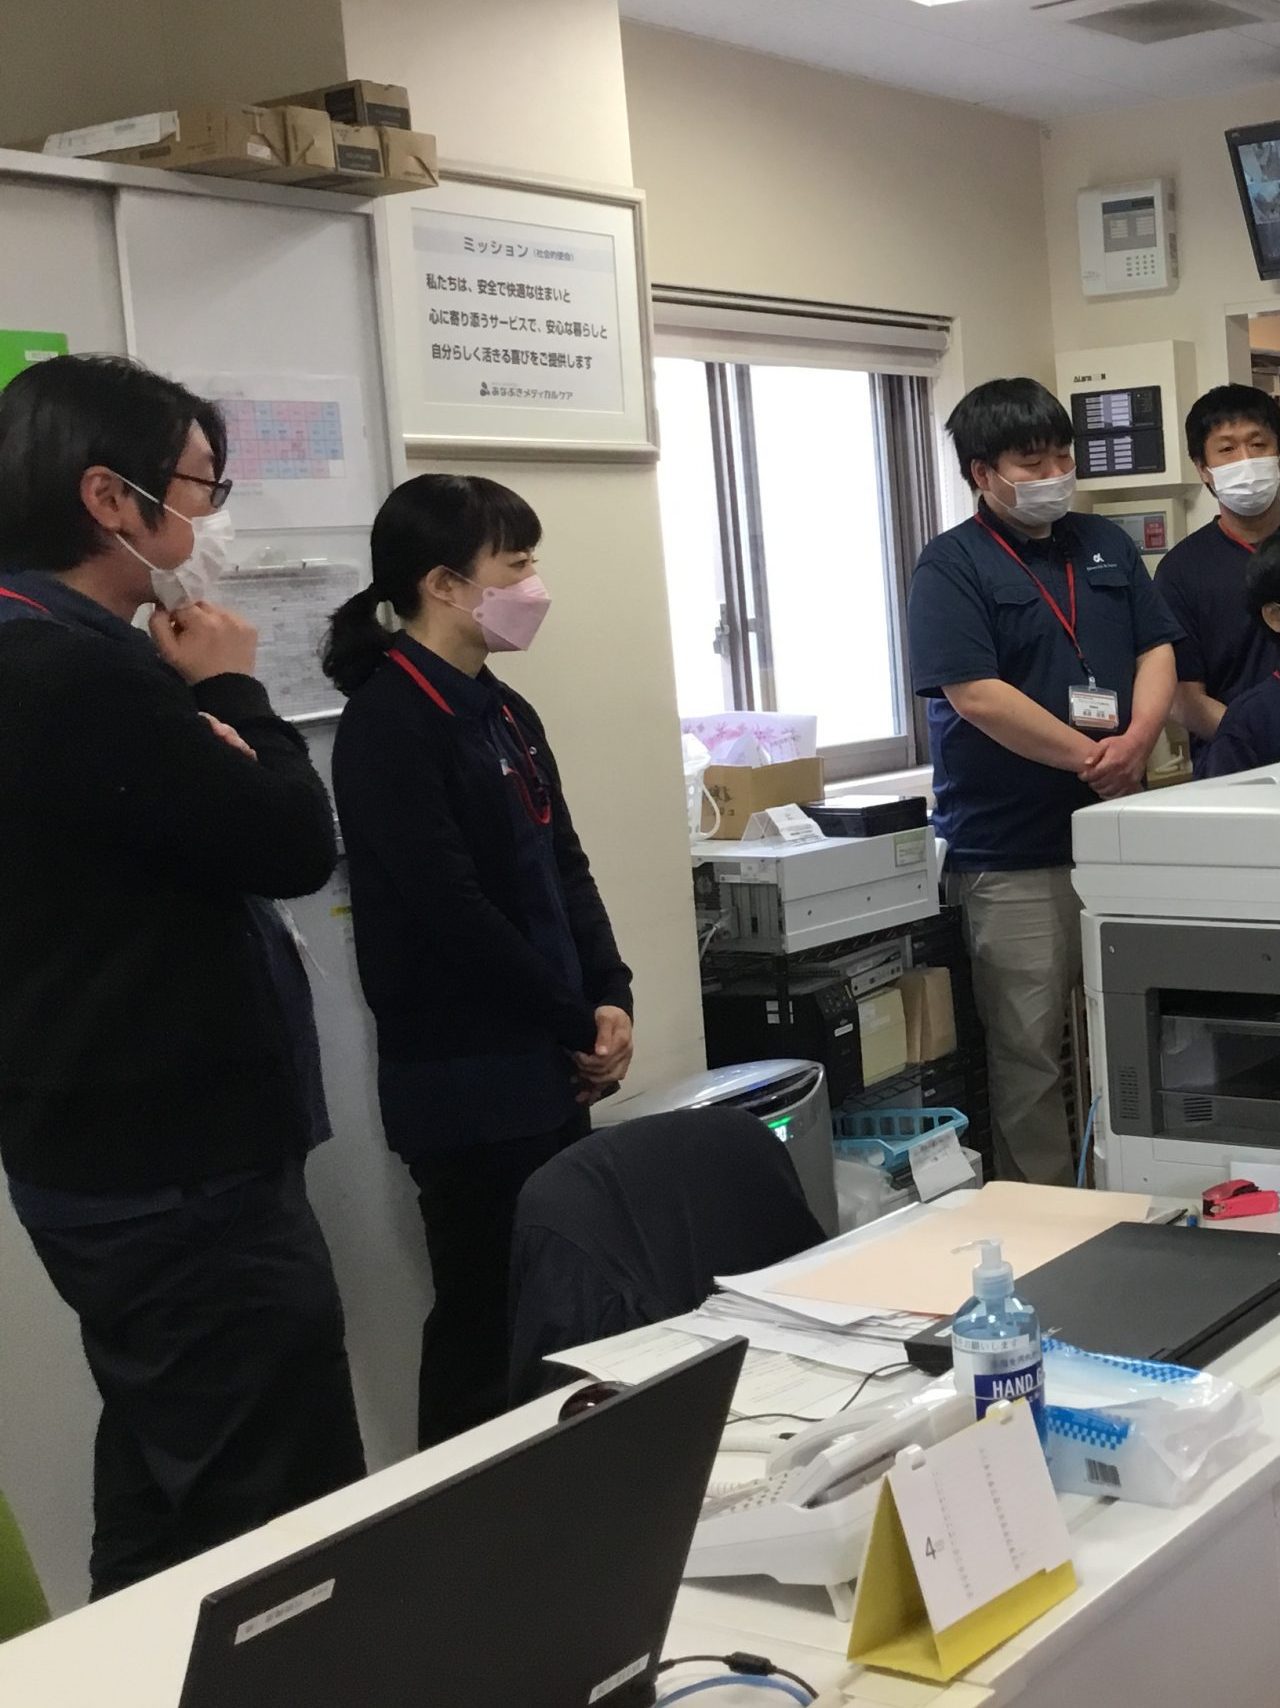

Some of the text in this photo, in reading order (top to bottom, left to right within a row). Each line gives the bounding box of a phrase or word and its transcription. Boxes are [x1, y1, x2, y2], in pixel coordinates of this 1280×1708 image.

[464, 236, 529, 258] ミッション
[425, 272, 571, 303] 私たちは、安全で快適な住まいと
[428, 308, 608, 339] 心に寄り添うサービスで、安心な暮らしと
[431, 343, 593, 370] 自分らしく活きる喜びをご提供します
[992, 1373, 1033, 1399] HAND
[925, 1536, 936, 1560] 4
